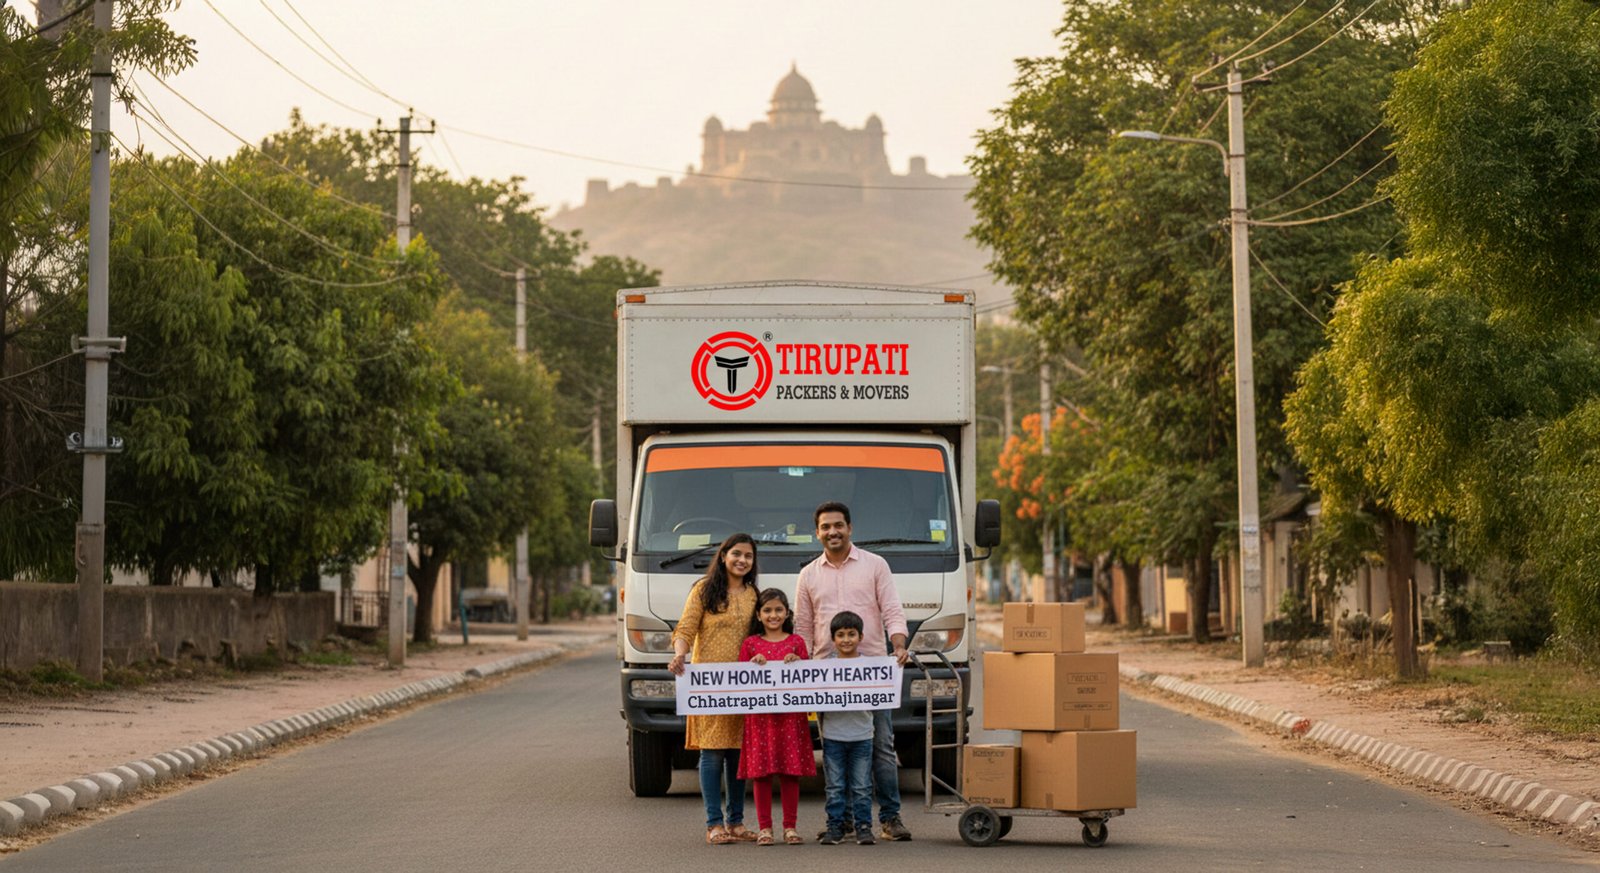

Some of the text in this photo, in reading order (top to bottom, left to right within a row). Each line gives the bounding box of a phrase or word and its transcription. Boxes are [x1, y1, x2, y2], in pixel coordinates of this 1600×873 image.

[776, 344, 909, 375] TIRUPATI
[776, 385, 909, 400] PACKERS & MOVERS
[690, 665, 893, 687] NEW HOME, HAPPY HEARTS!
[688, 690, 895, 710] Chhatrapati Sambhajinagar
